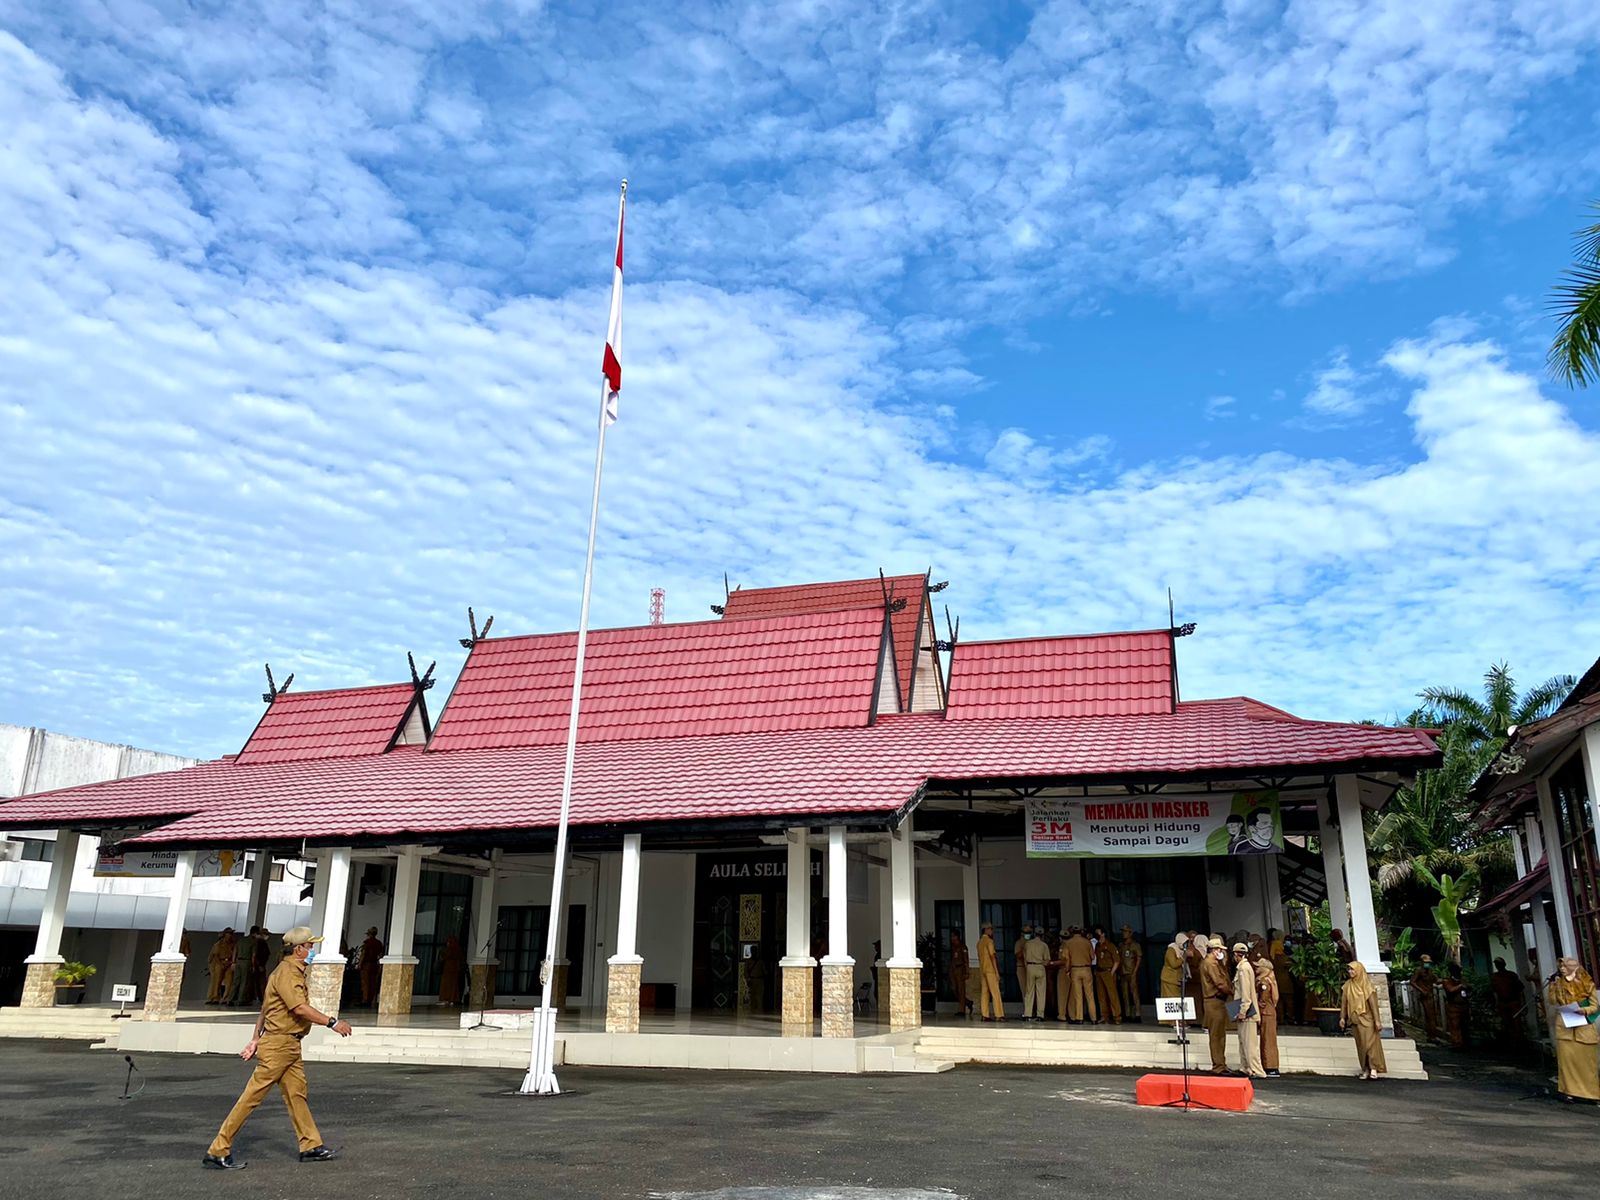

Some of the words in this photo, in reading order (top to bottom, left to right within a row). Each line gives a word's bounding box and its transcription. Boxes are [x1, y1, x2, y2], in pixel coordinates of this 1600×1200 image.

[1084, 802, 1149, 820] MEMAKAI
[1151, 801, 1210, 818] MASKER
[1031, 821, 1072, 834] 3M
[1090, 823, 1150, 834] Menutupi
[1154, 822, 1201, 833] Hidung
[1103, 835, 1151, 848] Sampai
[1155, 836, 1189, 847] Dagu
[709, 863, 751, 878] AULA
[754, 862, 821, 877] SELIH
